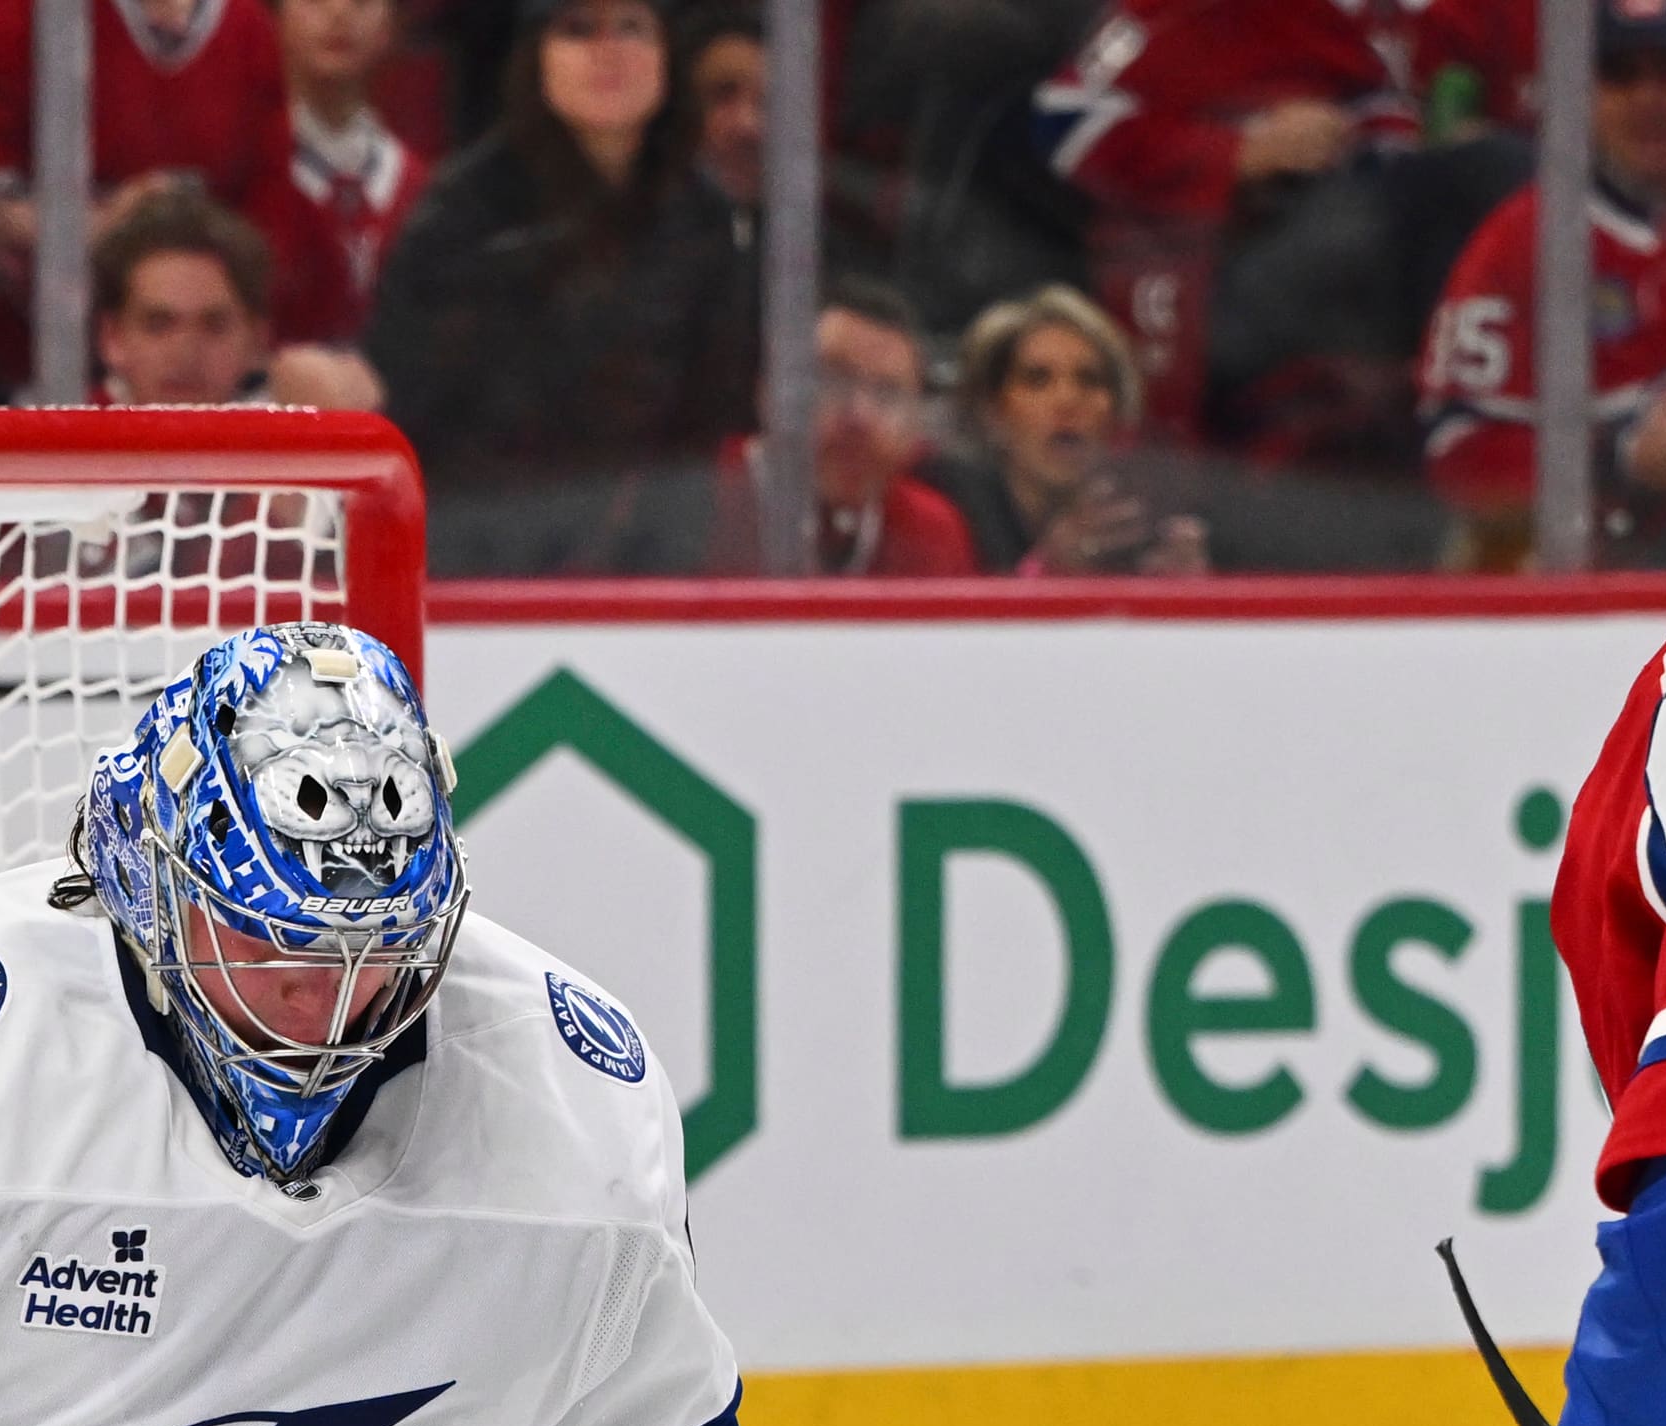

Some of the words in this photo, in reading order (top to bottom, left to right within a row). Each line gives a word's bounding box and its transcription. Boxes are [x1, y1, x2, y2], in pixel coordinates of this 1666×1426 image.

[553, 998, 579, 1038] BAY
[893, 785, 1563, 1222] Desj
[580, 1040, 635, 1078] TAMPA
[19, 1256, 158, 1298] Advent
[24, 1293, 152, 1335] Health
